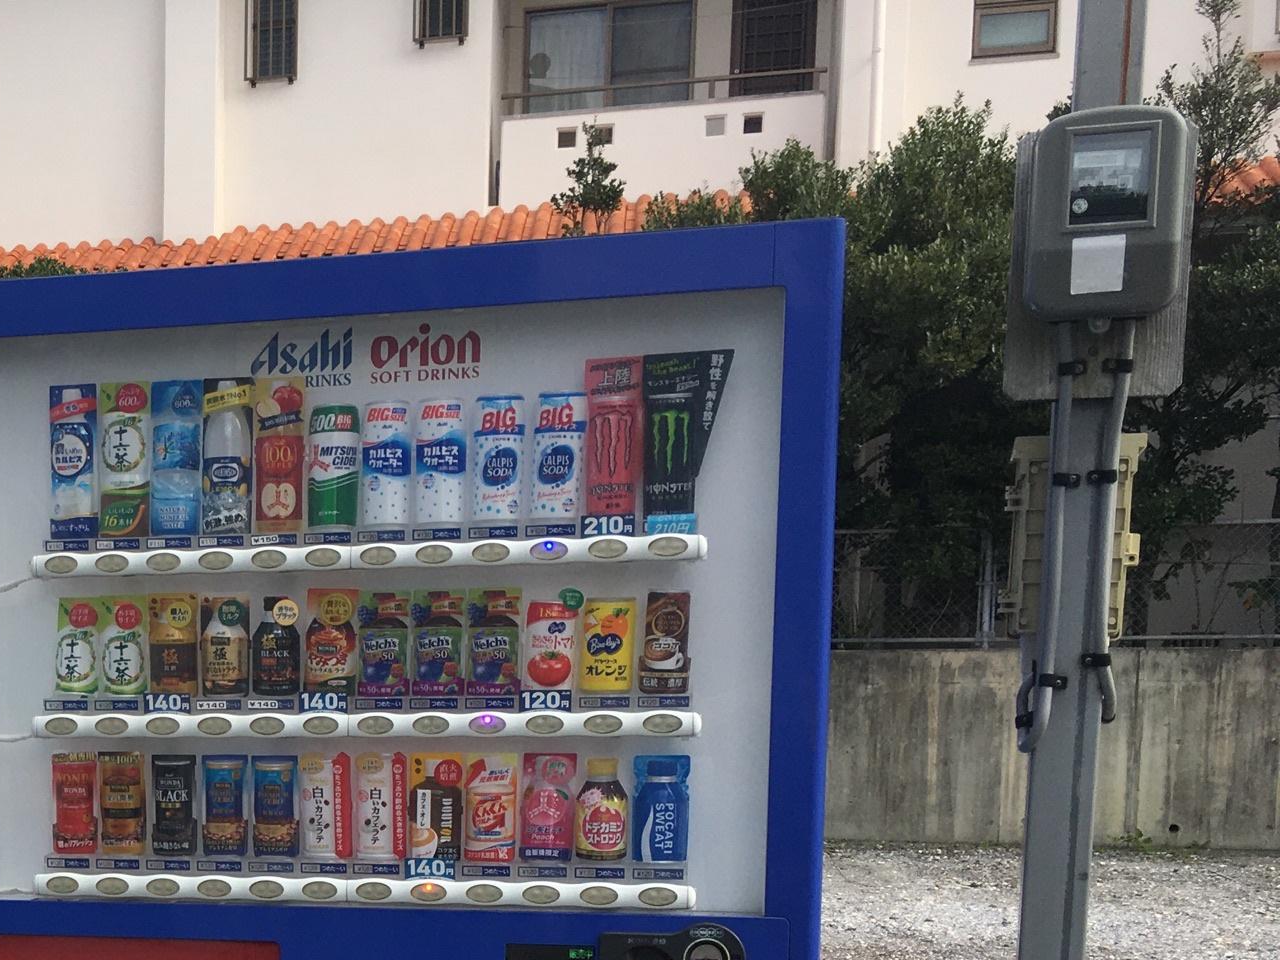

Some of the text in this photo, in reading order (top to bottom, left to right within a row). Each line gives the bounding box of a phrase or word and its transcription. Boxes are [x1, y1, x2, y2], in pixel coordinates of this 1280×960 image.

[251, 327, 352, 376] Asahi
[305, 372, 352, 388] RINKS
[370, 366, 480, 384] SOFT DRINKS
[598, 369, 631, 386] 上陸
[336, 414, 352, 424] BIG
[368, 408, 391, 423] BIG
[422, 405, 445, 419] BIG
[482, 407, 516, 431] BIG
[540, 404, 573, 429] BIG
[369, 448, 403, 458] カルピス
[423, 446, 459, 456] カルピス
[486, 458, 513, 468] CALPIS
[543, 456, 570, 466] CALPIS
[487, 467, 513, 477] SODA
[543, 465, 569, 475] SODA
[584, 515, 633, 535] 210円
[364, 637, 398, 651] Welch's
[473, 636, 508, 650] Welch's
[585, 664, 627, 677] オレンジ
[146, 694, 190, 710] 140円
[301, 693, 347, 709] 140円
[522, 691, 570, 709] 120円
[585, 822, 623, 833] ドデカミン
[655, 802, 665, 850] SWEAT
[663, 802, 675, 854] POCARI
[587, 833, 622, 844] ストロング
[408, 860, 454, 876] 140円
